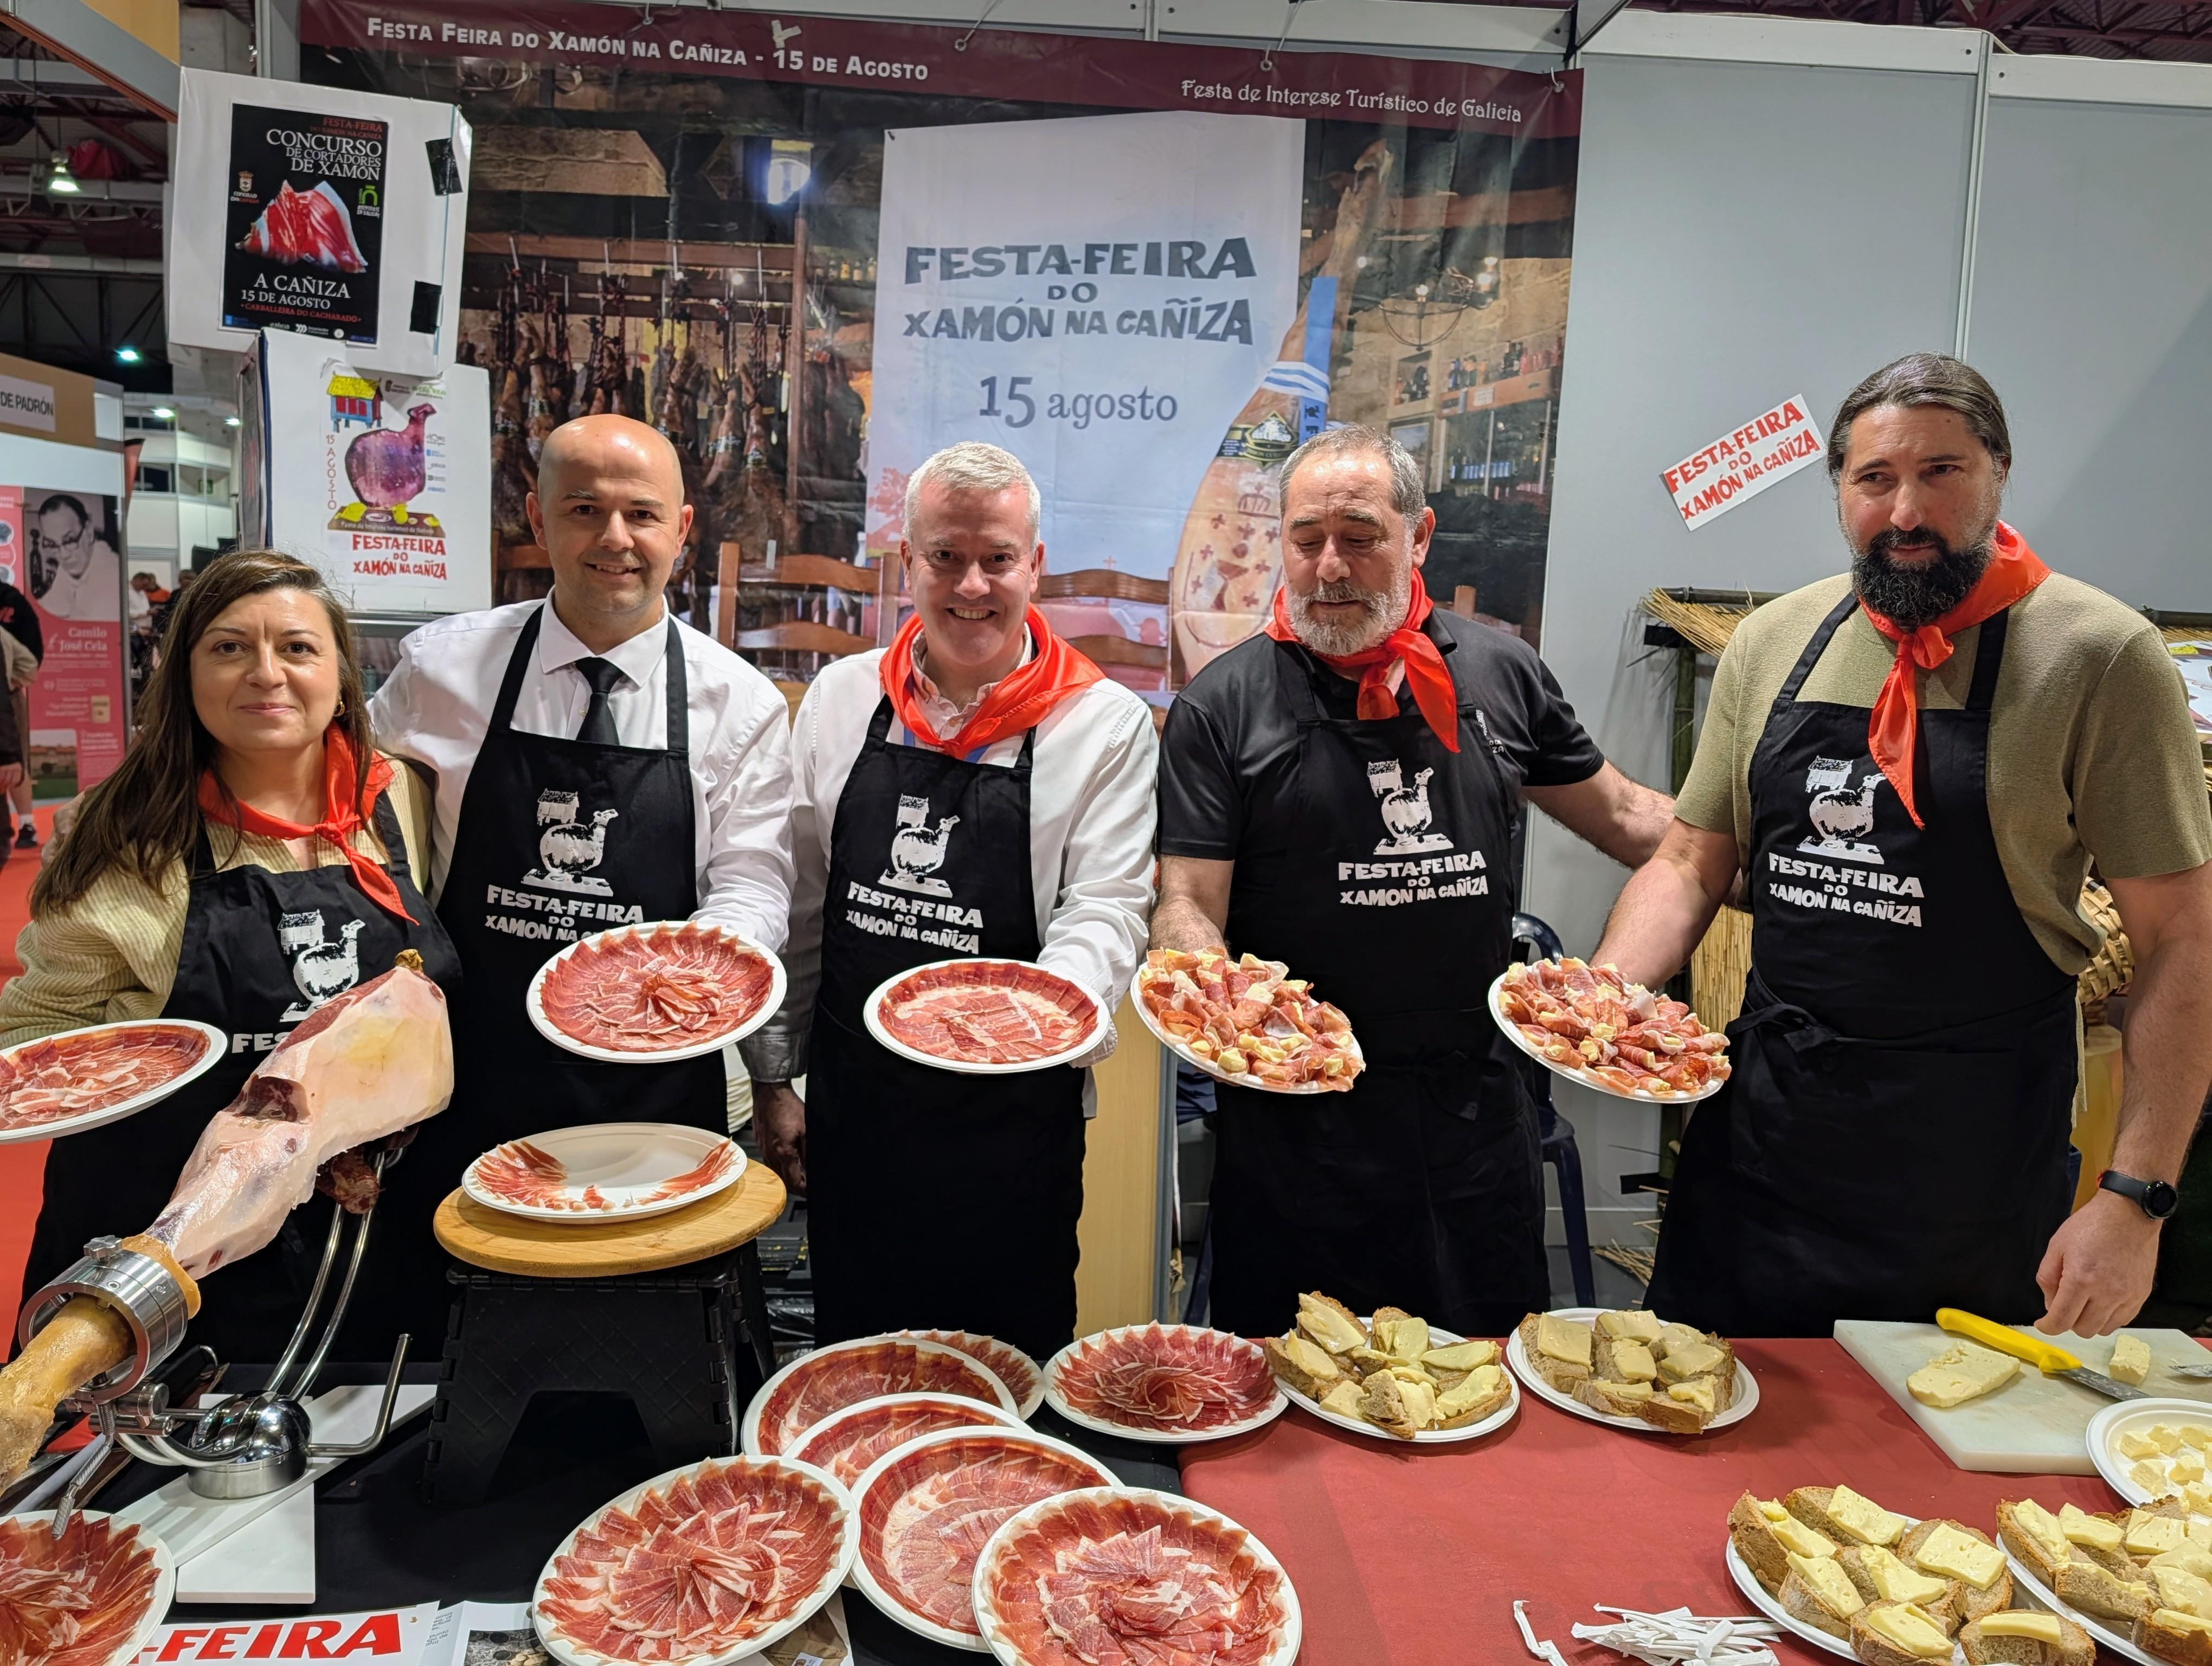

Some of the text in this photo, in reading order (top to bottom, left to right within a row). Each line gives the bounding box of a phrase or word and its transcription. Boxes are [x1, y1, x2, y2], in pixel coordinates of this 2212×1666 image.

[773, 49, 803, 71] 15
[1181, 79, 1521, 123] Festa de Interese Turístico de Galicia
[266, 129, 382, 157] CONCURSO
[286, 147, 381, 167] DE CORTADORES
[291, 157, 380, 181] DE XAMÓN
[904, 237, 1258, 285] FESTA-FEIRA
[254, 273, 351, 298] A CAÑIZA
[1047, 282, 1098, 303] DO
[241, 290, 330, 309] 15 DE AGOSTO
[902, 297, 1054, 343] XAMÓN
[1065, 310, 1109, 336] NA
[0, 392, 53, 416] DE PADRÓN
[979, 375, 1179, 430] 15 agosto
[1665, 401, 1804, 494] FESTA-FEIRA
[326, 434, 337, 510] 15 AGOSTO
[1728, 451, 1752, 471] DO
[1681, 472, 1744, 520] XAMÓN
[1744, 463, 1764, 483] NA
[352, 534, 446, 556] FESTA-FEIRA
[393, 552, 408, 561] DO
[353, 557, 397, 576] XAMÓN
[400, 563, 411, 574] NA
[1339, 850, 1487, 881] FESTA-FEIRA
[1769, 852, 1925, 898] FESTA-FEIRA
[1407, 876, 1431, 887] DO
[1824, 884, 1848, 896] DO
[487, 884, 644, 923] FESTA-FEIRA
[847, 881, 983, 928] FESTA-FEIRA
[1340, 889, 1413, 906] XAMON
[1417, 887, 1437, 901] NA
[1769, 883, 1828, 908] XAMON
[1830, 898, 1850, 912] NA
[485, 915, 578, 941] XAMON NA
[549, 916, 575, 927] DO
[846, 909, 898, 937] XAMON
[900, 925, 918, 940] NA
[895, 914, 917, 925] DO
[130, 1613, 401, 1664] -FEIRA
